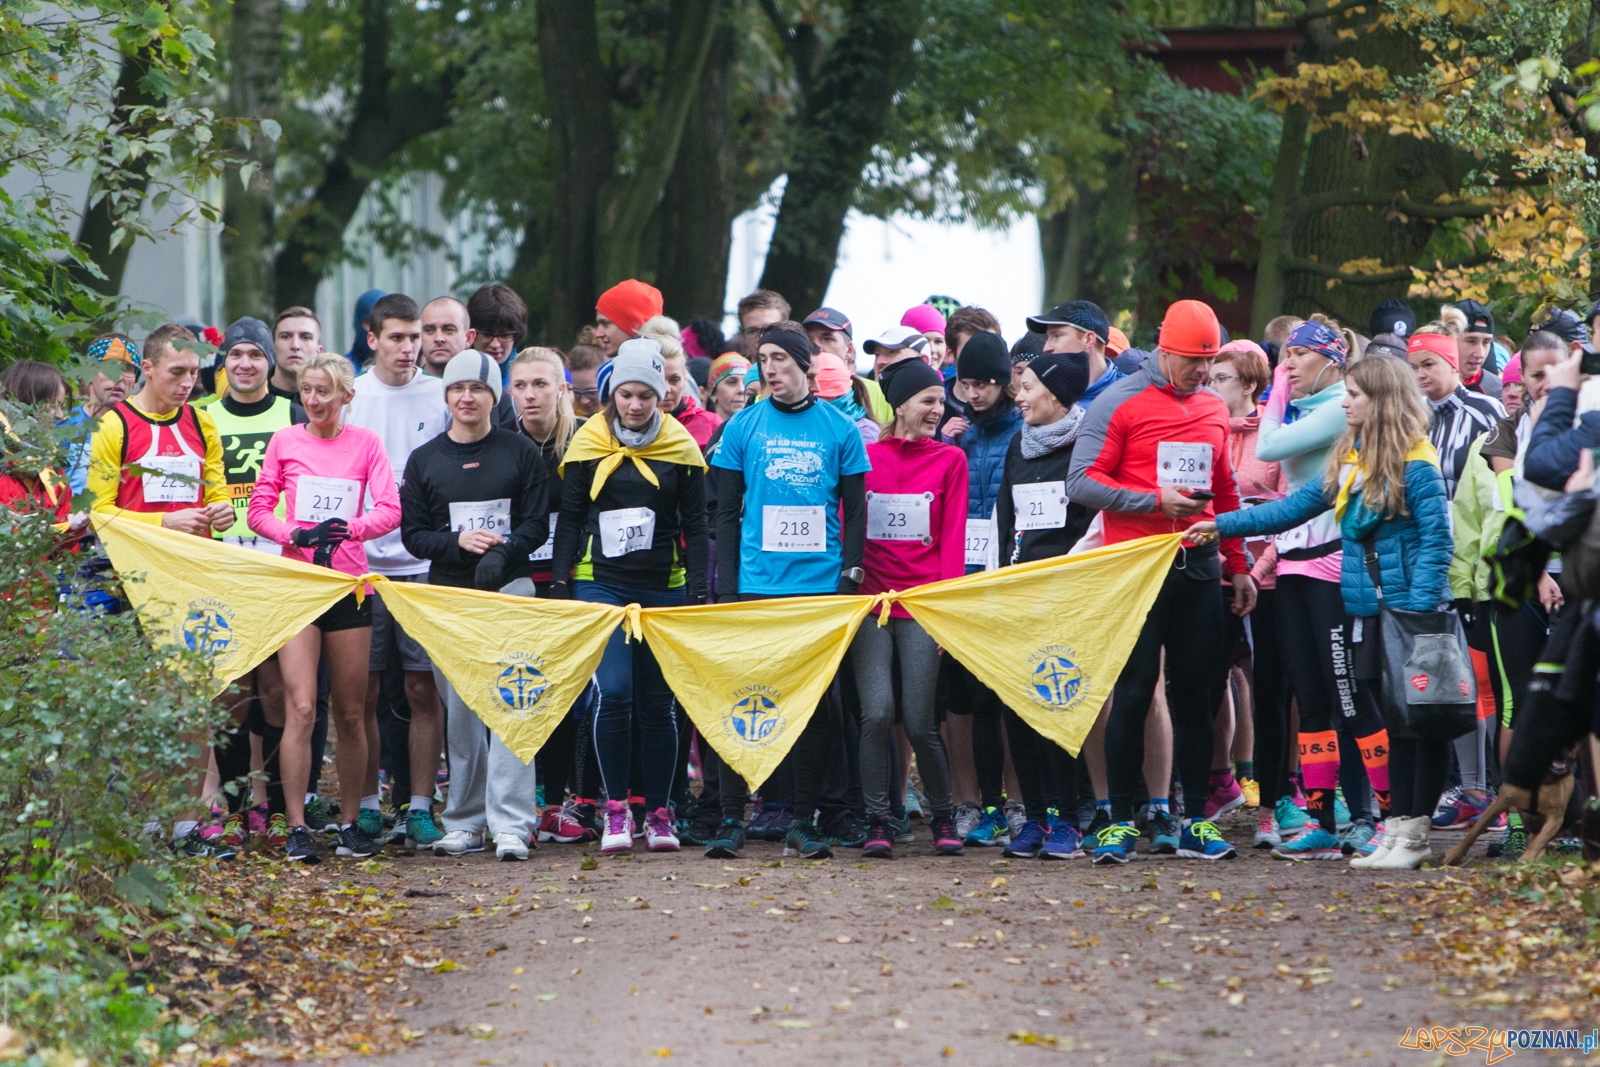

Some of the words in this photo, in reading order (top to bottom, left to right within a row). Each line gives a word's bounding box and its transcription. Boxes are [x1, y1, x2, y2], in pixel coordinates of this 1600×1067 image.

[1178, 457, 1196, 473] 28
[312, 494, 343, 511] 217
[1029, 501, 1045, 516] 21
[467, 515, 496, 530] 126
[887, 512, 907, 527] 23
[617, 525, 646, 542] 201
[780, 521, 810, 536] 218
[965, 537, 989, 552] 127
[187, 597, 236, 620] FUNDACJA
[1027, 644, 1076, 665] FUNDACJA
[1329, 624, 1348, 676] SHOP.PL
[496, 651, 545, 668] FUNDACJA
[732, 684, 782, 701] FUNDACJA
[1336, 678, 1357, 718] SENSEI
[1309, 743, 1325, 754] &
[1326, 741, 1337, 752] S
